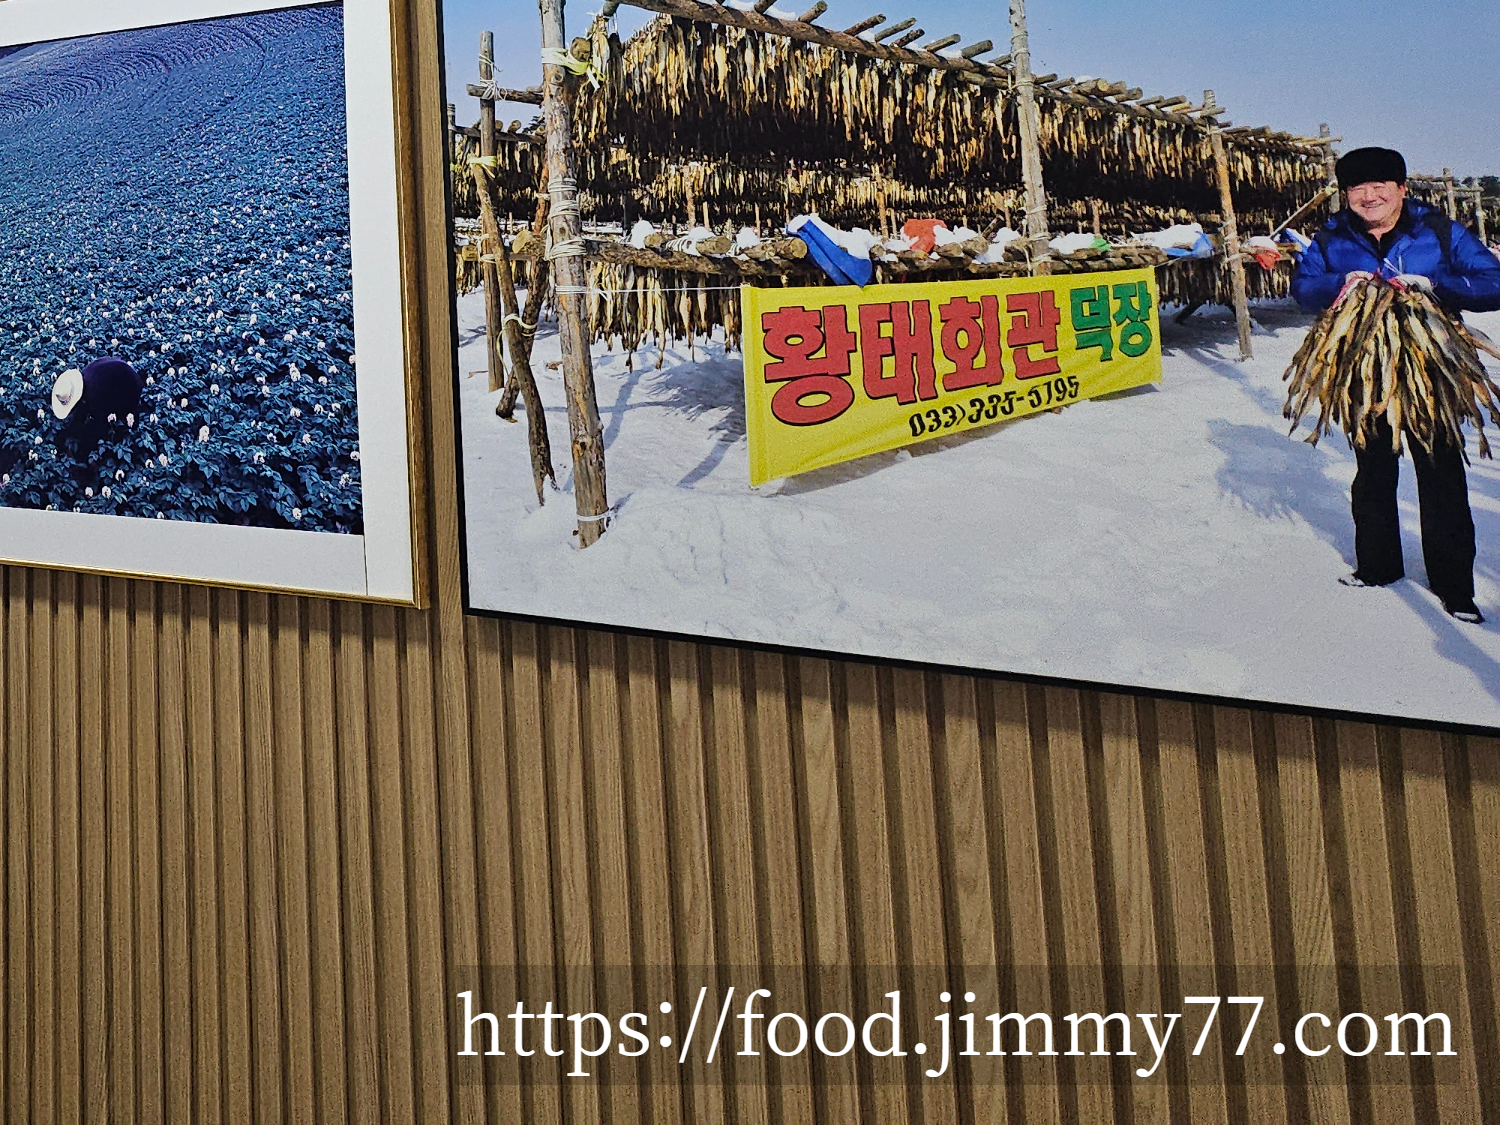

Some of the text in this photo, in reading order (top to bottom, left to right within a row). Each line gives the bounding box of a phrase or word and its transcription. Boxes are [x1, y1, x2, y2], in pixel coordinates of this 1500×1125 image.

[762, 280, 1154, 427] 황태회관 덕장
[910, 375, 1080, 438] 033)335-5795
